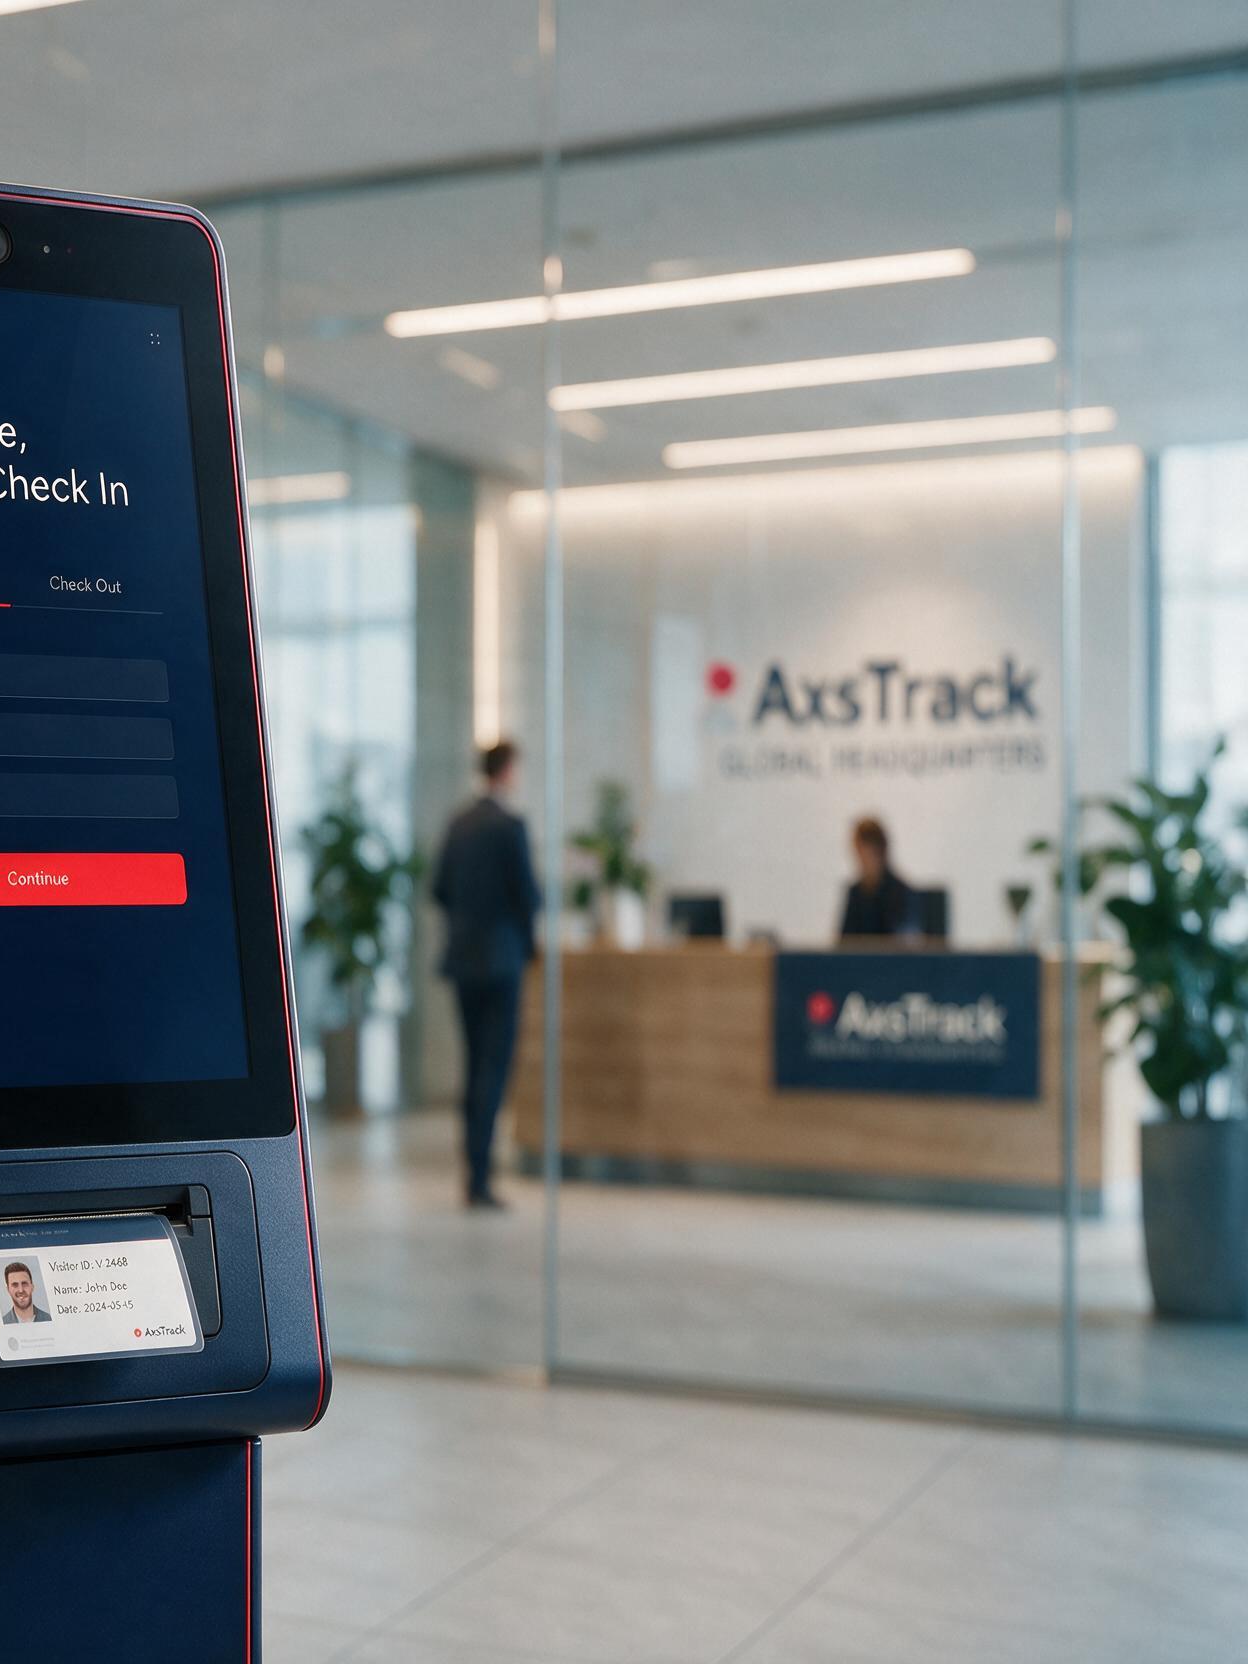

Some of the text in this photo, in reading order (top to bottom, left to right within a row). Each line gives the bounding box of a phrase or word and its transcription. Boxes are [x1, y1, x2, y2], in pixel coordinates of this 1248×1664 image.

[99, 471, 129, 507] In
[49, 575, 122, 595] Check Out
[752, 652, 1040, 727] AxsTrack
[7, 870, 70, 887] Continue
[80, 1260, 94, 1271] ID:
[85, 1282, 108, 1294] John
[144, 1324, 187, 1338] AxsTrack
